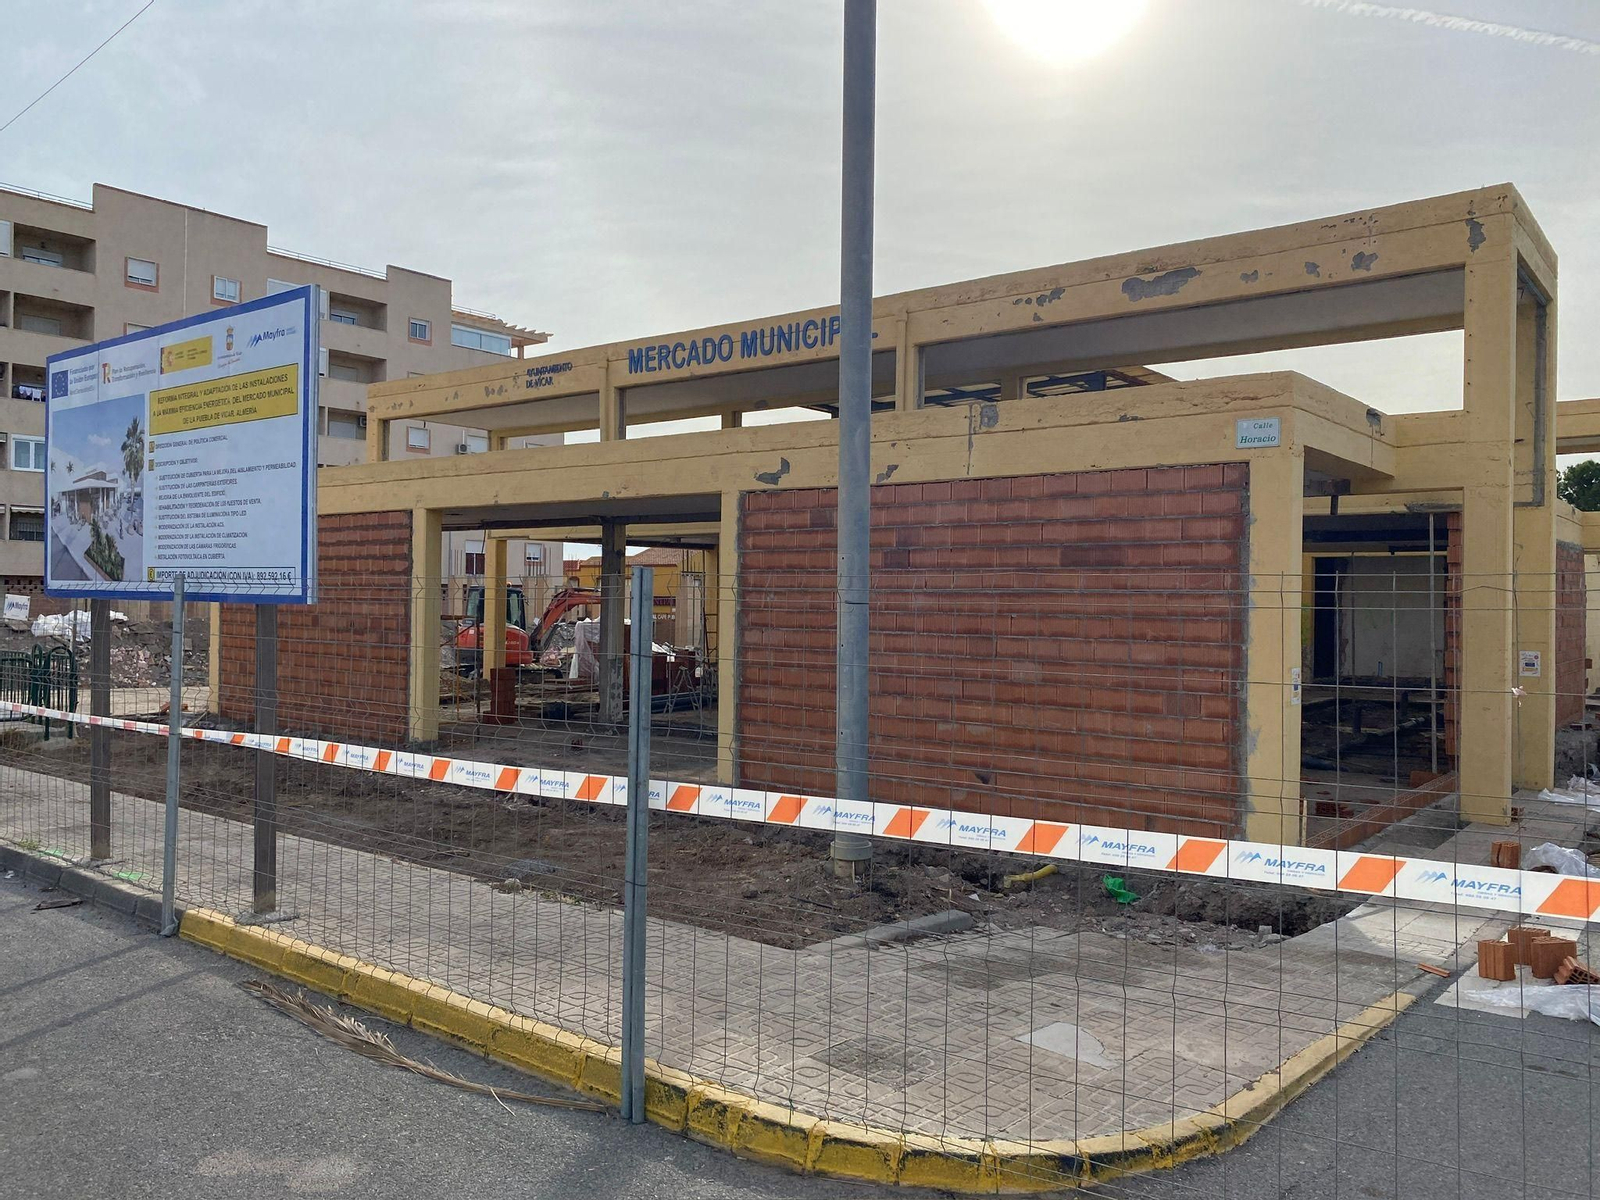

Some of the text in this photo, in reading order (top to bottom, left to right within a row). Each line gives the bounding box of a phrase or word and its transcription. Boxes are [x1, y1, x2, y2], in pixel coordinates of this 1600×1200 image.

[628, 315, 878, 374] MERCADO MUNICIP
[527, 362, 572, 377] AYUNTAMIENTO
[158, 395, 177, 404] REFORMA
[178, 390, 199, 400] INTEGRAL
[232, 383, 238, 391] DE
[240, 381, 248, 390] LAS
[250, 373, 288, 387] INSTALACIONES
[526, 380, 533, 388] DE
[179, 404, 202, 413] EFICIENCIA
[232, 396, 242, 404] DEL
[243, 391, 266, 402] MERCADO
[268, 387, 294, 397] MUNICIPAL
[196, 414, 213, 422] PUEBLA
[1240, 434, 1276, 443] Horacio
[228, 571, 241, 581] (CON
[466, 770, 490, 778] MAYFRA
[540, 780, 570, 788] MAYFRA
[724, 799, 760, 809] MAYFRA
[834, 811, 875, 821] MAYFRA
[959, 825, 1006, 837] MAYFRA
[1101, 841, 1155, 853] MAYFRA
[1264, 858, 1325, 872] MAYFRA
[1451, 879, 1521, 895] MAYFRA
